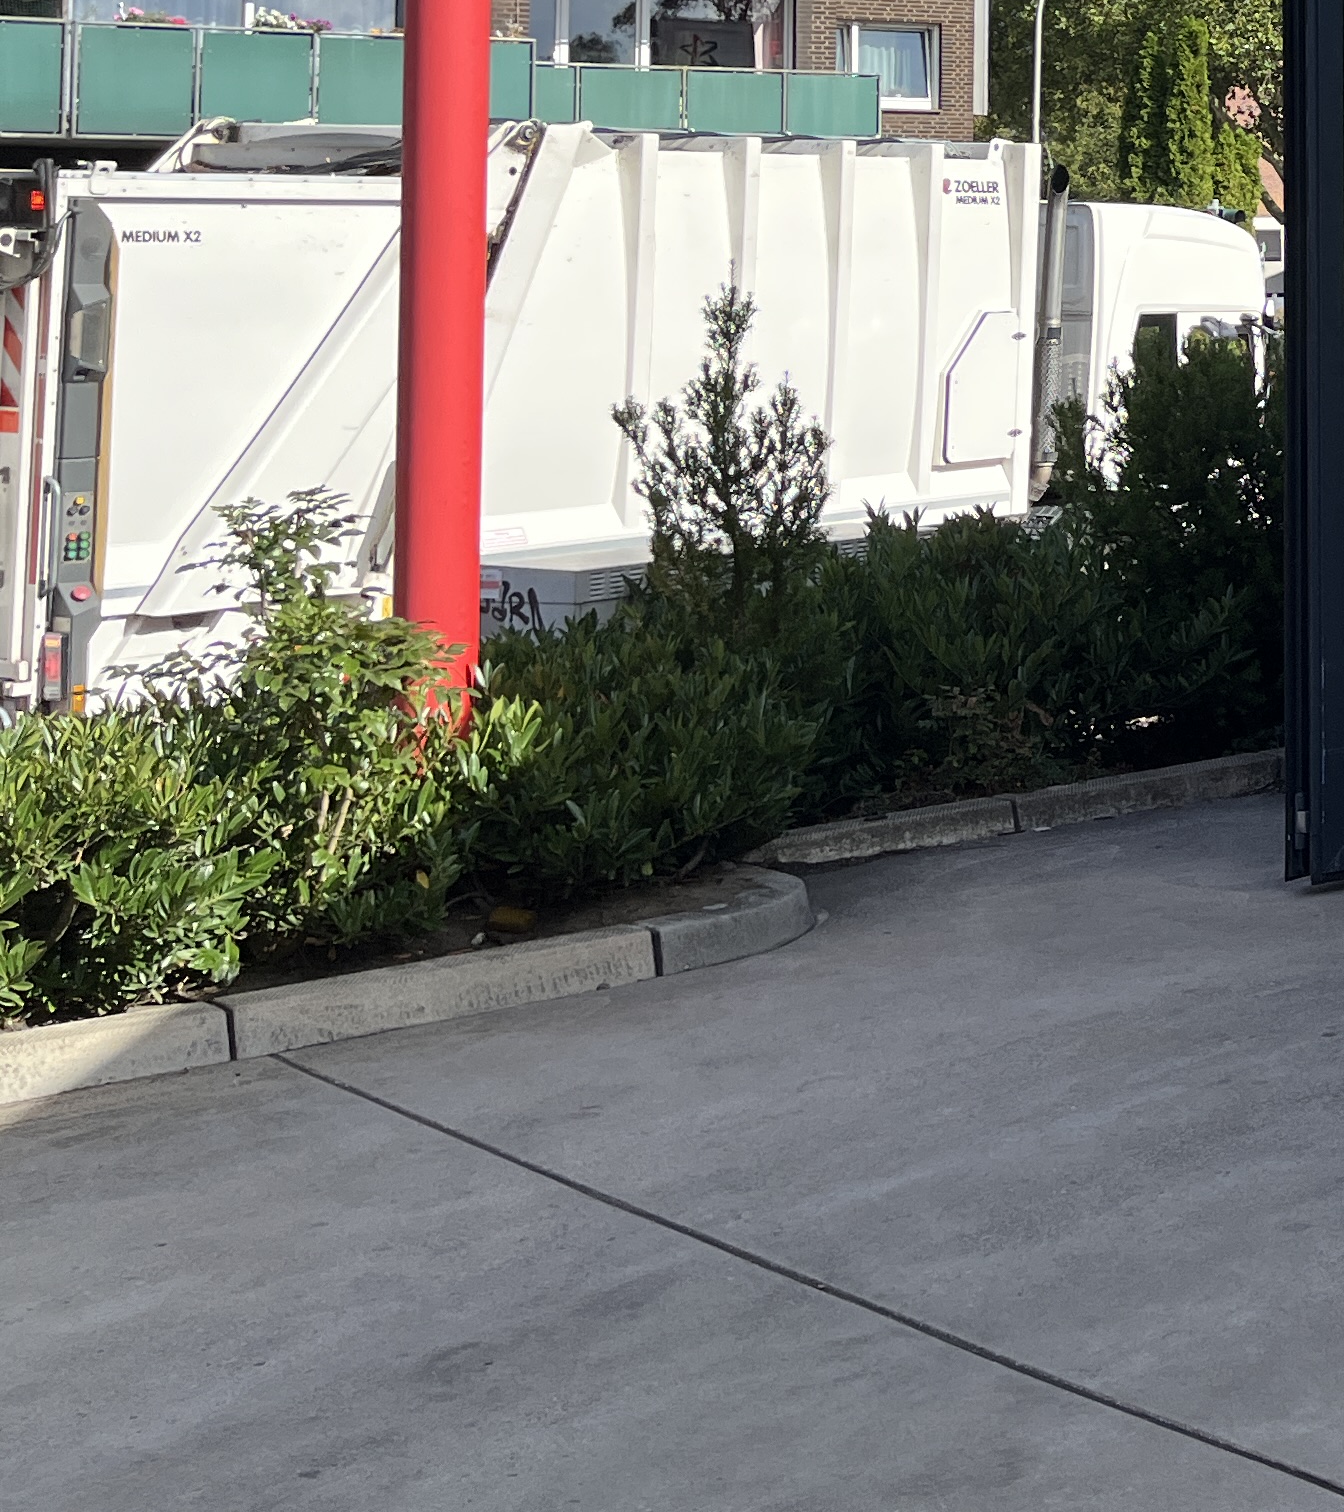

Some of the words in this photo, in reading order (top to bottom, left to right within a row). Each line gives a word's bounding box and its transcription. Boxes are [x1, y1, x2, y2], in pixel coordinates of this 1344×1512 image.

[954, 179, 1000, 194] ZOELLER
[955, 195, 989, 206] MEDIUM
[121, 230, 180, 243] MEDIUM
[183, 230, 202, 243] X2
